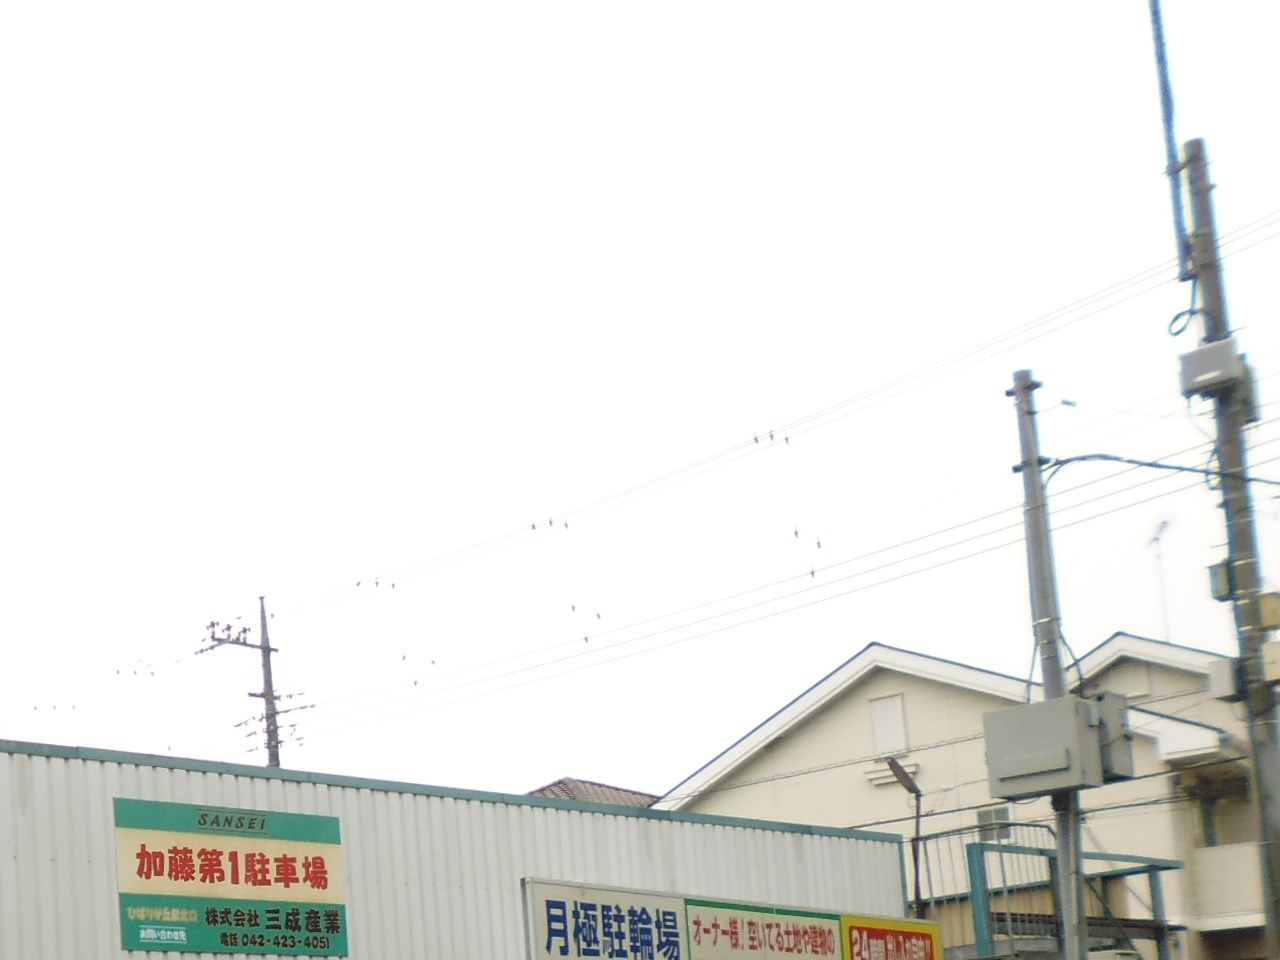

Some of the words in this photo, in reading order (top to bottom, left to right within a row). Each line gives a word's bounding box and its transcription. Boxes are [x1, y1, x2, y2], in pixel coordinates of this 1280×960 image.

[197, 813, 267, 831] SANSEI
[135, 843, 329, 891] 加藤第1駐車場
[205, 906, 260, 928] 株式会社
[265, 908, 341, 935] 三成産業
[220, 932, 239, 947] 電話
[241, 933, 331, 950] 042-423-4051
